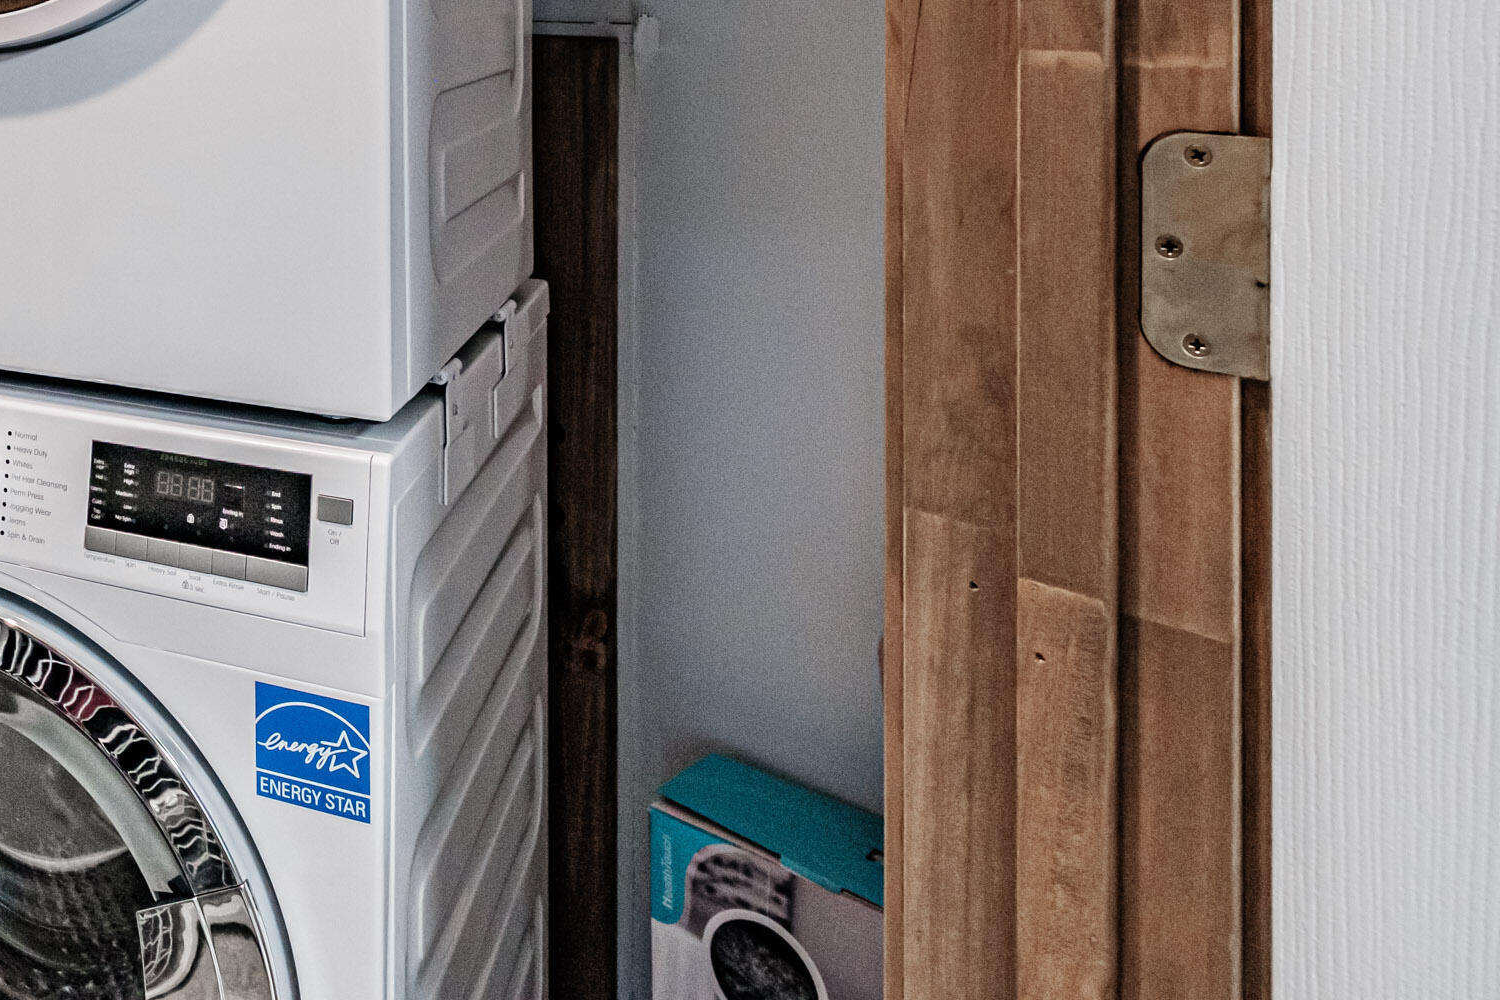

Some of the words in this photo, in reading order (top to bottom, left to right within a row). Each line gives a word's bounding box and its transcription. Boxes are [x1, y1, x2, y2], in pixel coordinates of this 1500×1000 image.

[15, 431, 37, 441] Normal
[14, 445, 32, 455] Heavy
[34, 449, 48, 458] Duty
[13, 460, 33, 469] Whites
[37, 478, 68, 491] Cleansing
[10, 488, 26, 497] Perm
[28, 491, 45, 500] Press
[9, 503, 33, 515] Jogging
[35, 507, 51, 516] Wear
[9, 517, 26, 526] Jeans
[7, 531, 20, 540] Spin
[28, 535, 46, 544] Drain
[257, 732, 347, 770] energy
[260, 776, 322, 806] ENERGY
[325, 793, 367, 818] STAR
